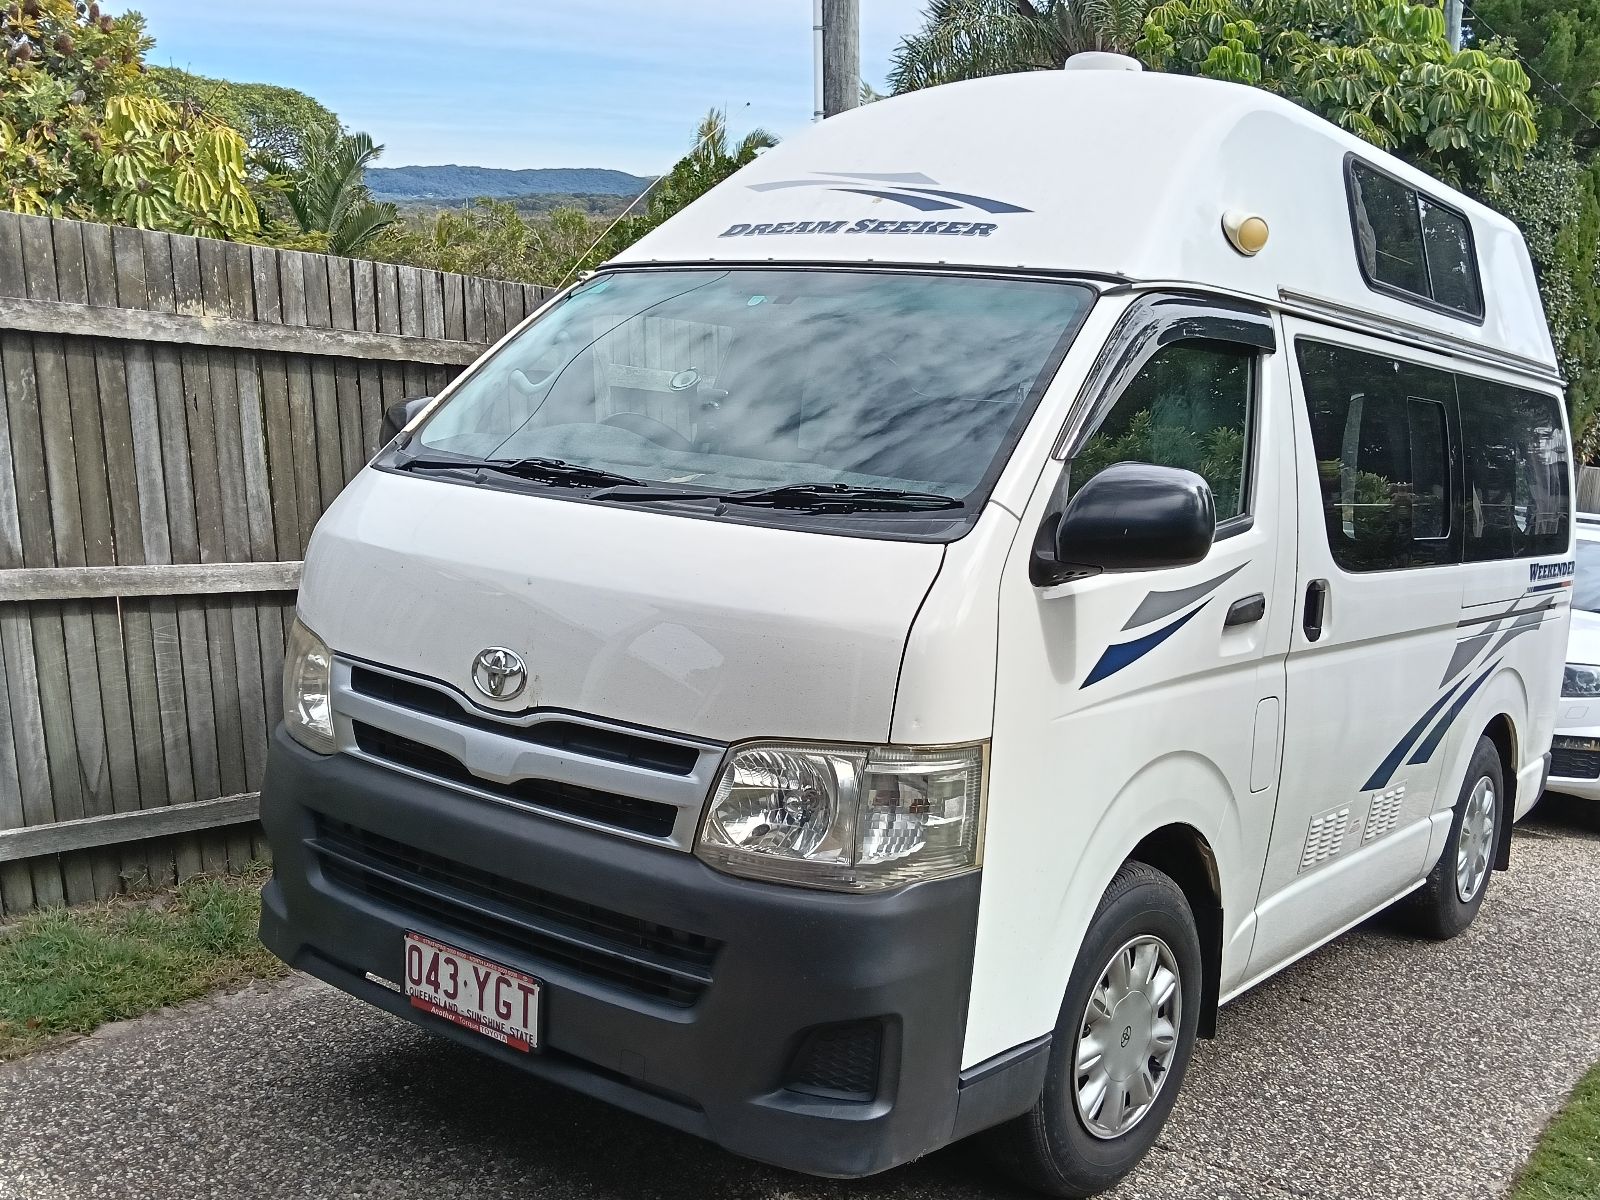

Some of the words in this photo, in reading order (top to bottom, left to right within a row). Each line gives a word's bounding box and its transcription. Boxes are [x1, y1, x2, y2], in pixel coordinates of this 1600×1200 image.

[717, 219, 849, 239] DREAM
[844, 218, 999, 238] SEEKER
[1529, 560, 1576, 582] WEEKENDER
[409, 986, 458, 1012] QUEENSLAND
[466, 1008, 506, 1033] SUNSHINE
[509, 1026, 534, 1044] STATE
[430, 1005, 456, 1021] Another
[480, 1025, 508, 1043] TOYOTA
